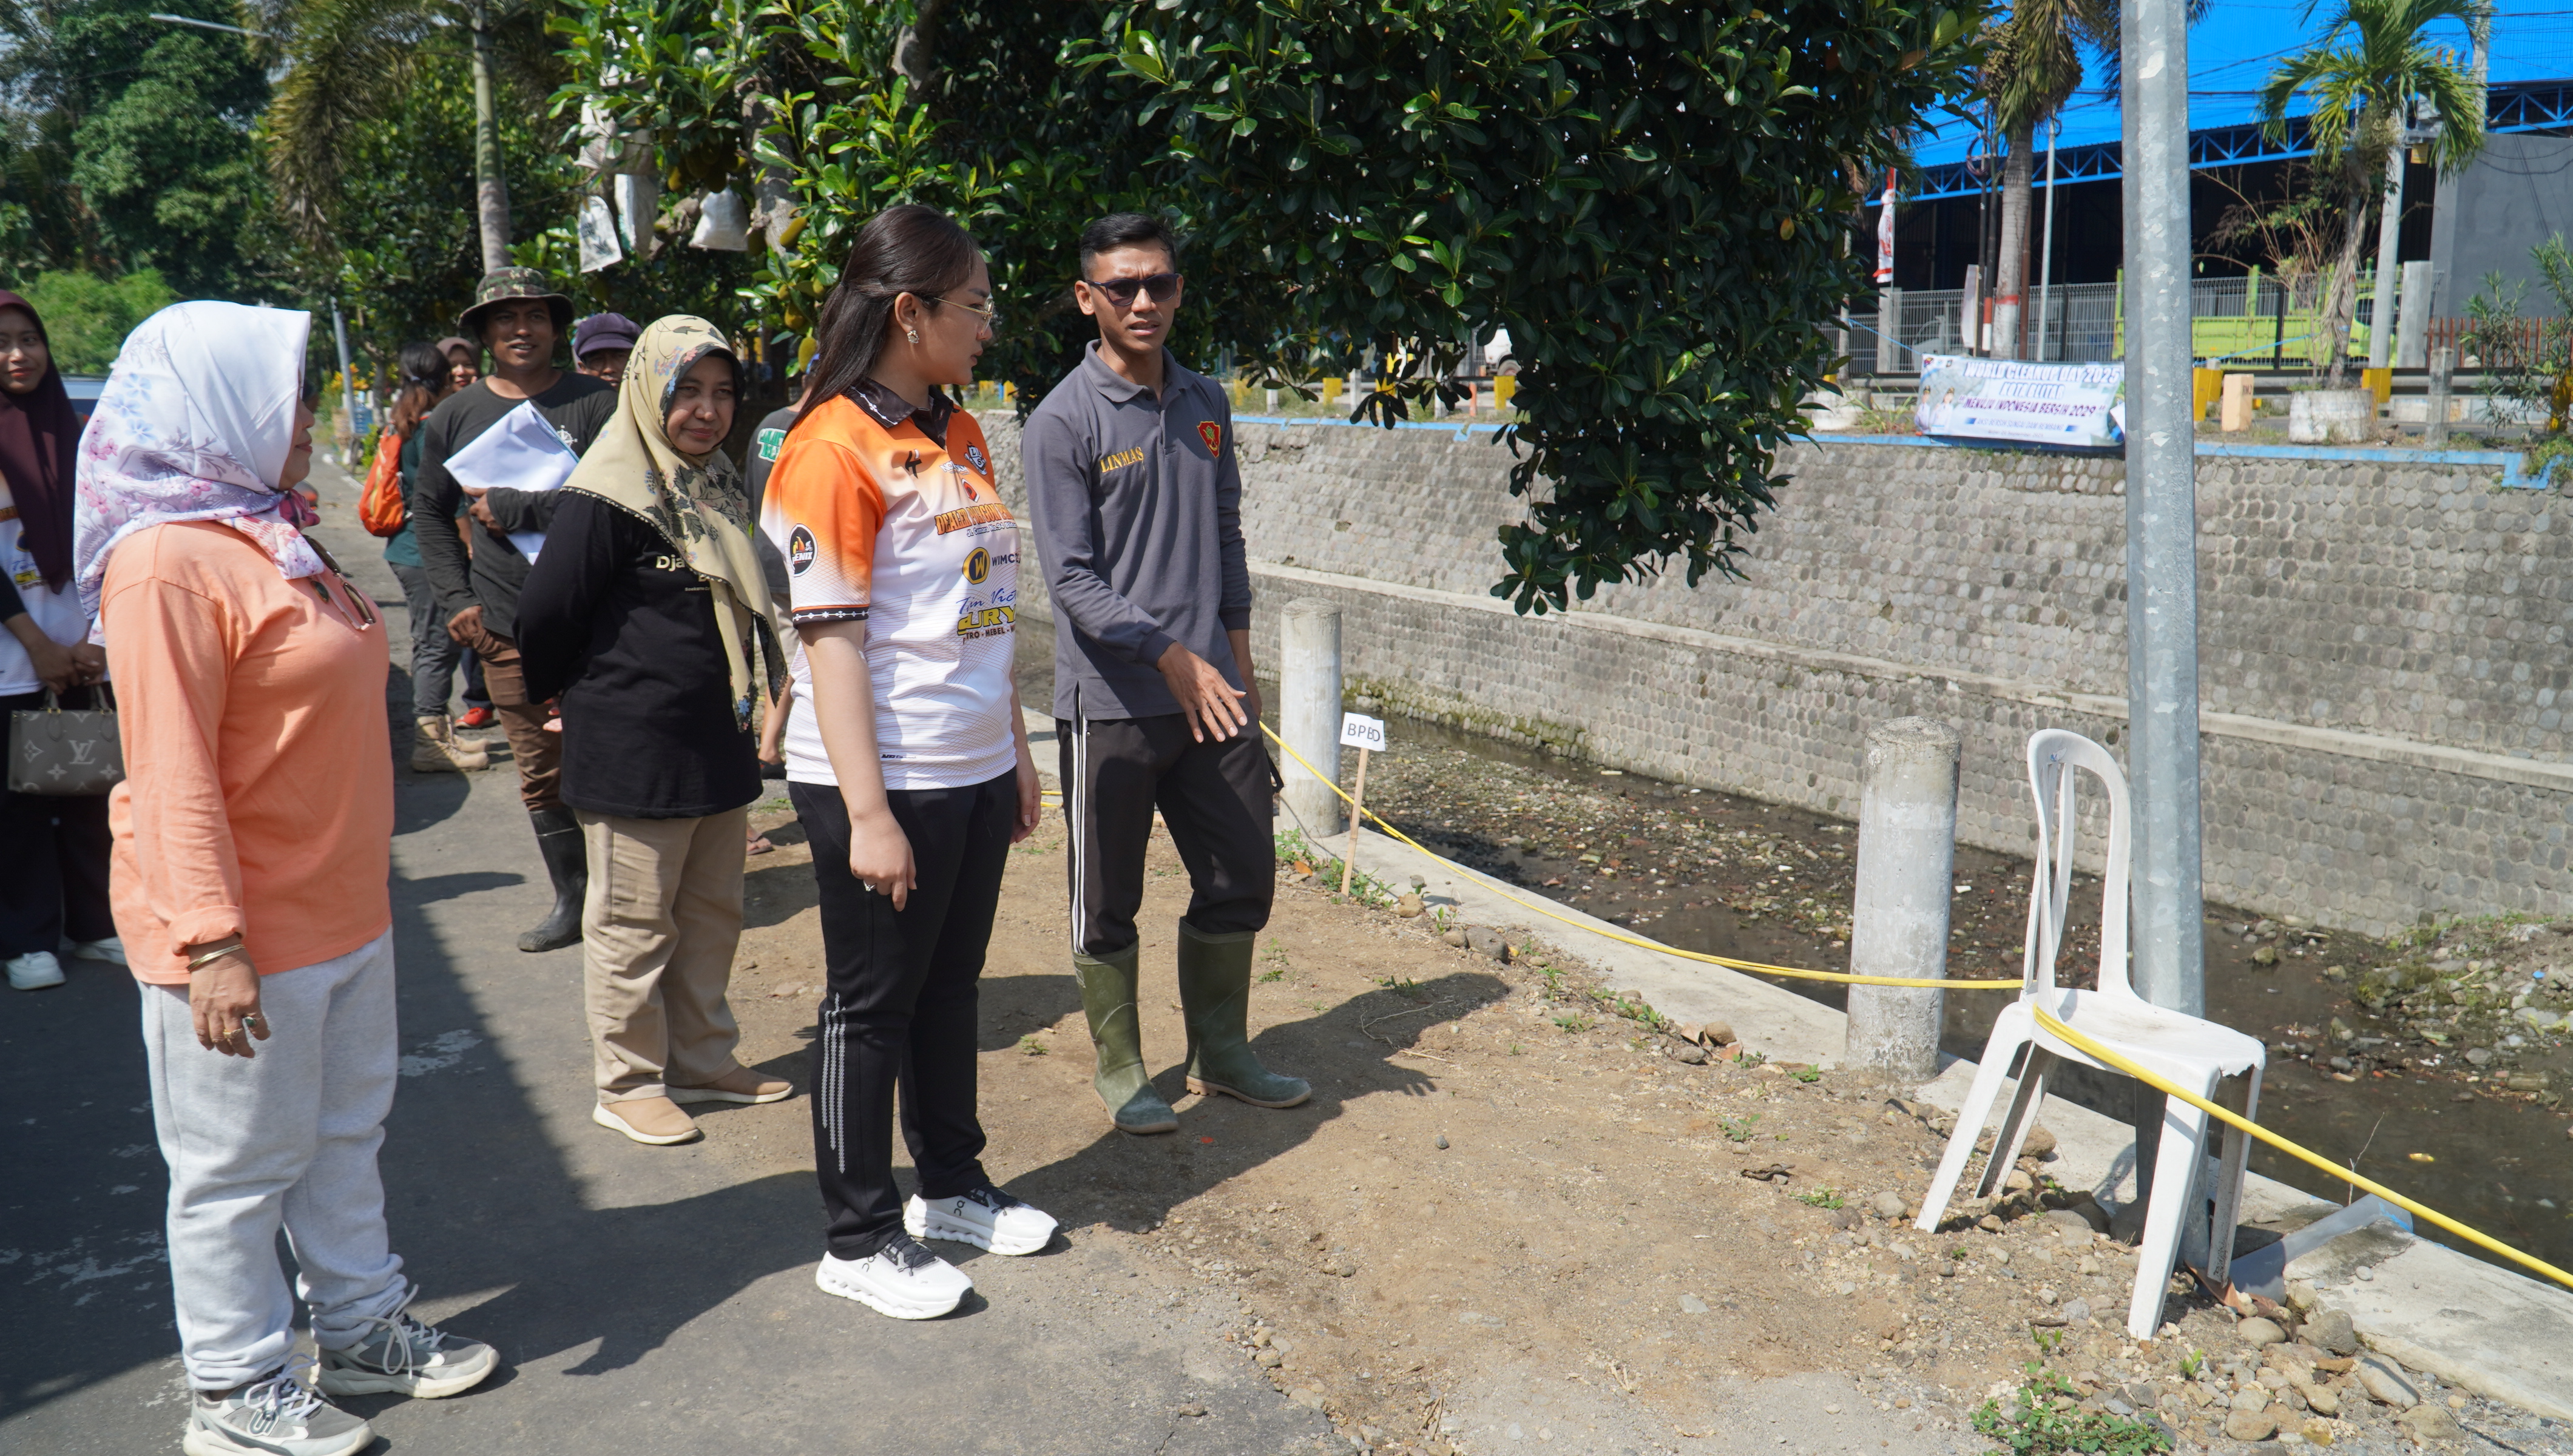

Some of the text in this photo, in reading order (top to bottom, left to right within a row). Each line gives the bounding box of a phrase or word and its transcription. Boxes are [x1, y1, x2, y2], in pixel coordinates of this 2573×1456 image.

[1963, 362, 2120, 384] WORLD CLEANUP DAY 2025
[2000, 382, 2065, 400] KOTA BLITAR
[1995, 399, 2038, 413] INDONESIA
[2039, 402, 2070, 415] BERSIH
[2069, 404, 2097, 417] 2029
[1100, 447, 1144, 473] LINMAS
[935, 507, 973, 535] DEALER
[656, 554, 686, 572] Dja
[992, 553, 1021, 567] WIMC
[985, 627, 1005, 636] MEBEL
[1347, 723, 1381, 742] BPBD
